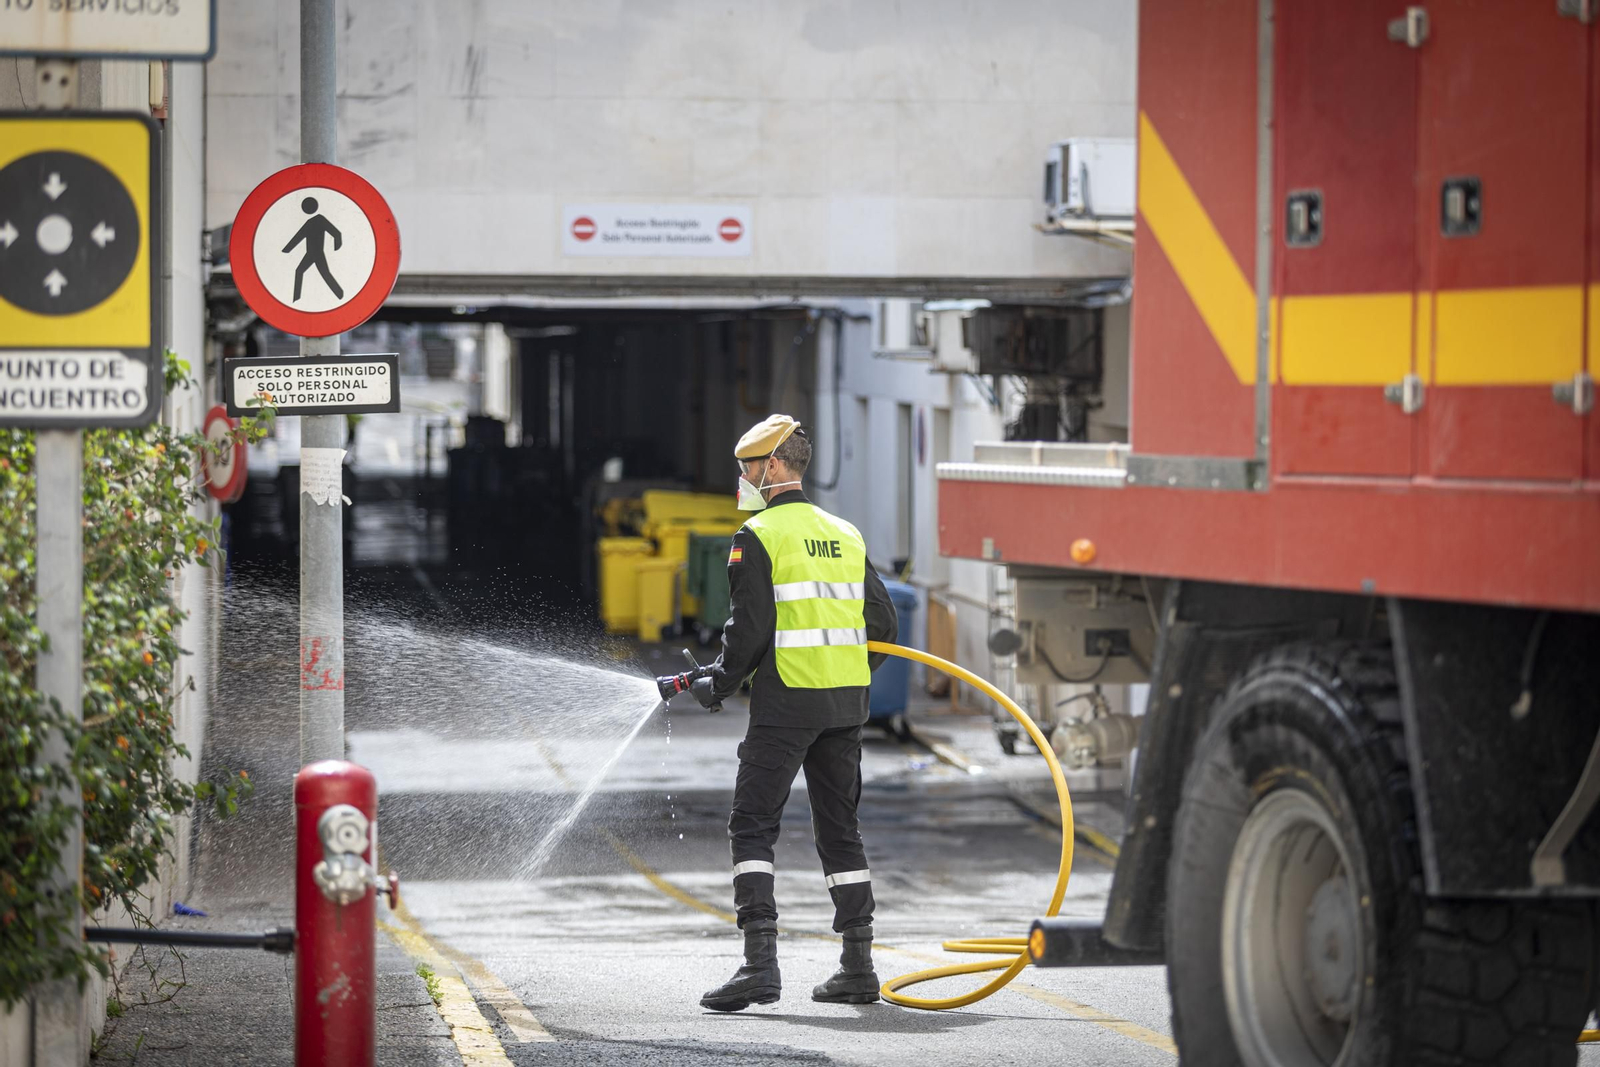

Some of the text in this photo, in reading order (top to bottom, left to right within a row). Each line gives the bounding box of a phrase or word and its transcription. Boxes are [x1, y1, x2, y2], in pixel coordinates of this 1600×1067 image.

[0, 359, 125, 380] UNTO DE
[237, 365, 387, 380] ACCESO RESTRINGIDO
[257, 380, 368, 392] SOLO PERSONAL
[271, 392, 356, 404] AUTORIZADO
[803, 539, 842, 558] UME
